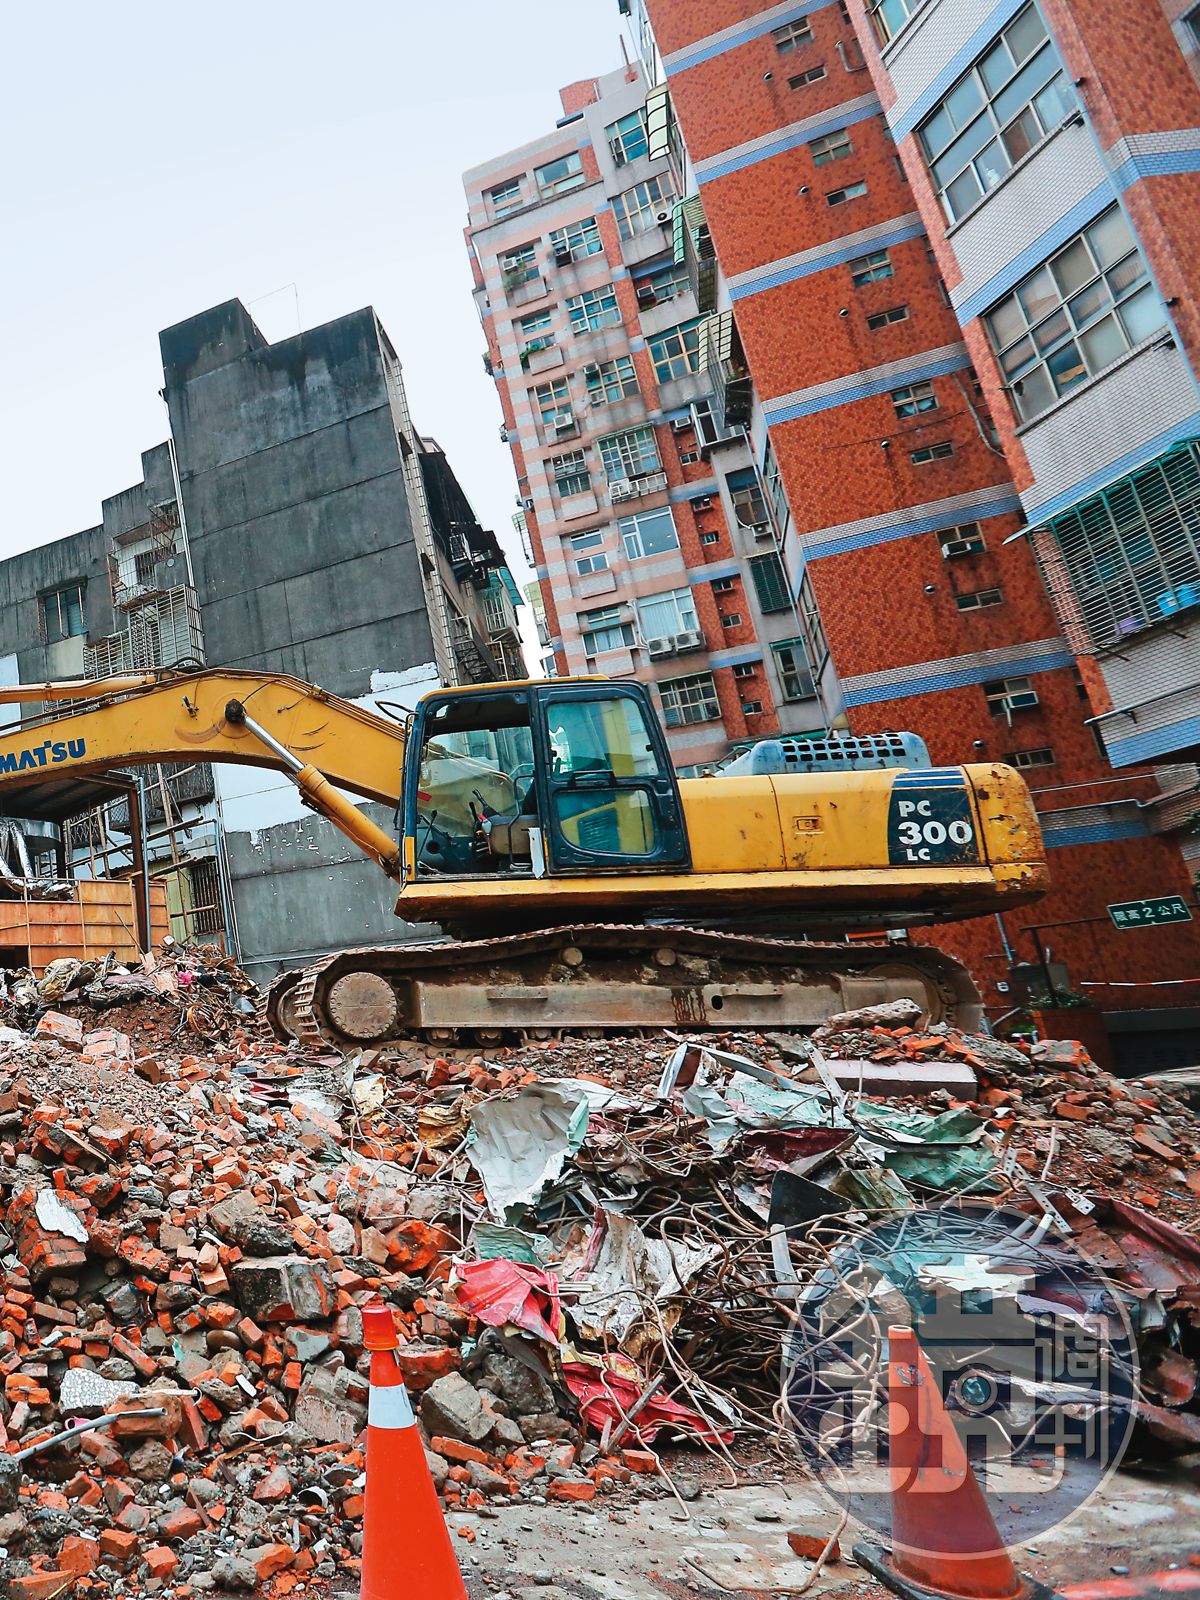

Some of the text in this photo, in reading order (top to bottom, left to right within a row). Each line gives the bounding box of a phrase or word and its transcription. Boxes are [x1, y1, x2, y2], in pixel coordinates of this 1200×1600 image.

[897, 799, 932, 817] PC
[897, 820, 973, 845] 300
[905, 847, 931, 861] LC
